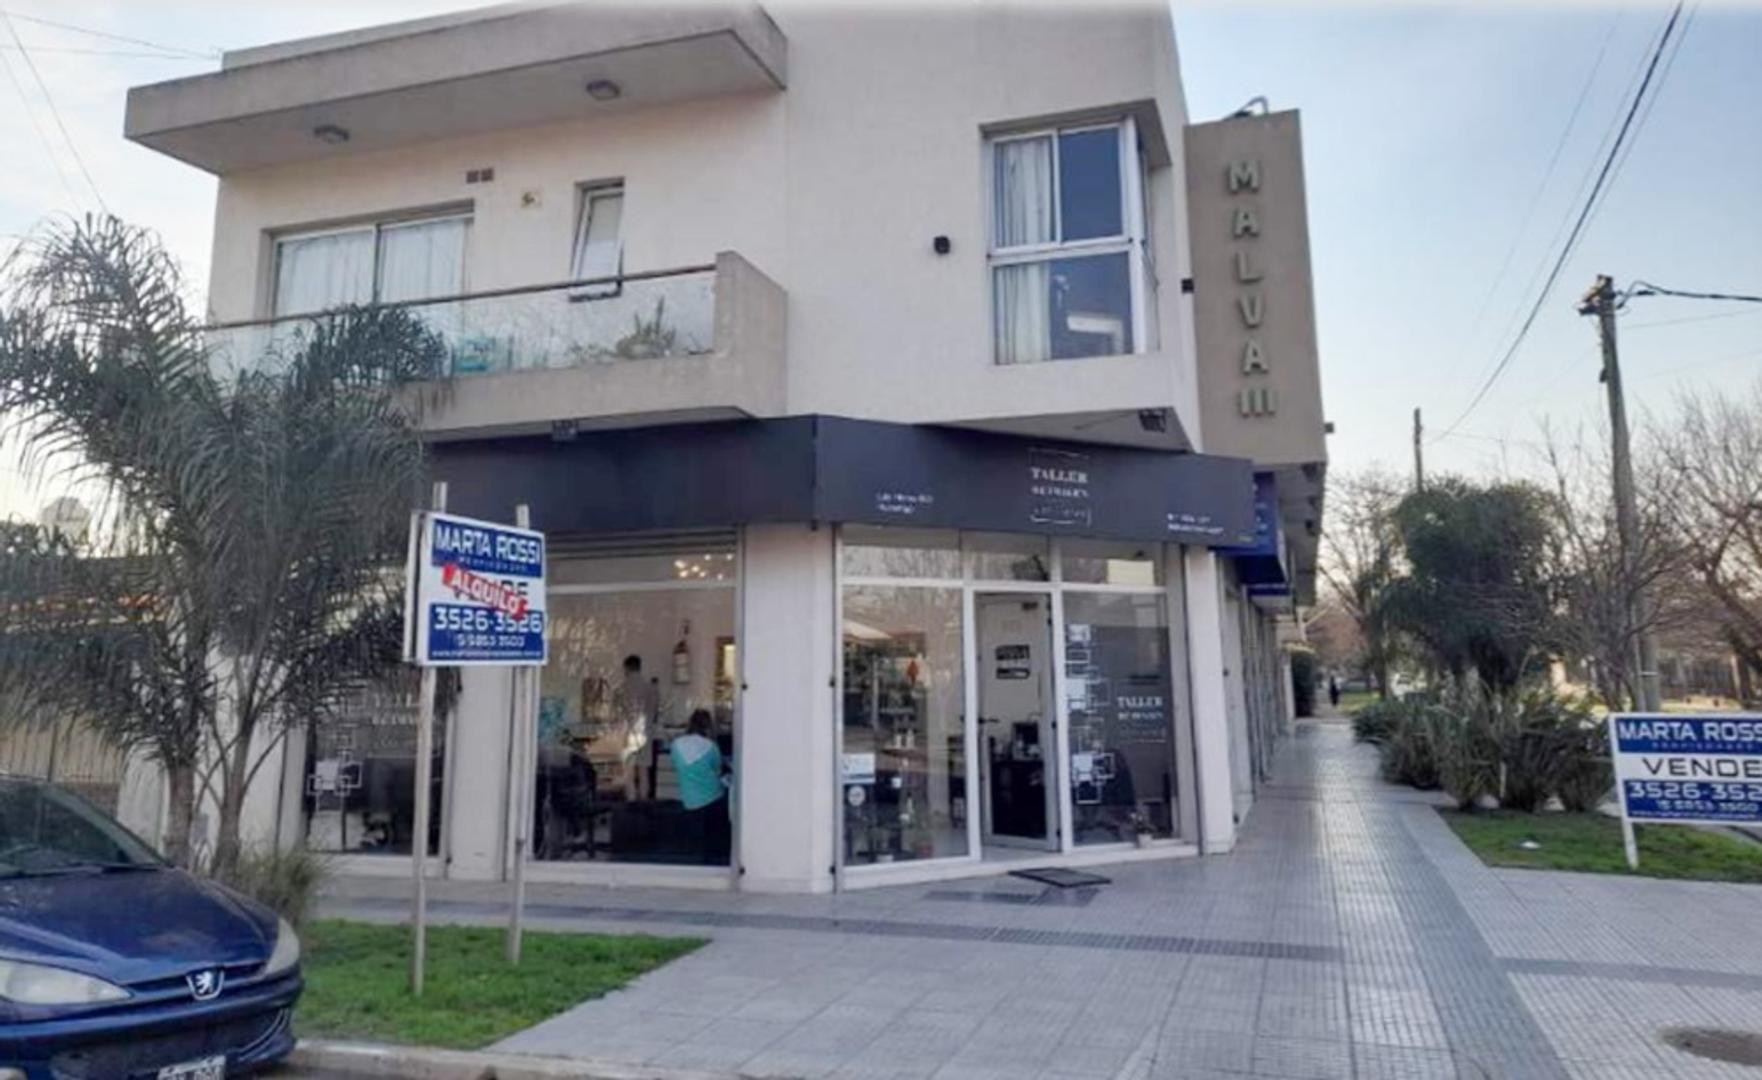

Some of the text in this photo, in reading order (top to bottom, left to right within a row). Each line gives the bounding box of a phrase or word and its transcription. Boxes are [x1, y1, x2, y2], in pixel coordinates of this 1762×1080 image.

[1030, 466, 1089, 484] TALLER
[435, 524, 492, 558] MARTA
[496, 535, 541, 564] ROSSI
[450, 566, 520, 615] ALQUILO
[1618, 721, 1697, 741] MARTA
[1642, 757, 1762, 778] VENDE
